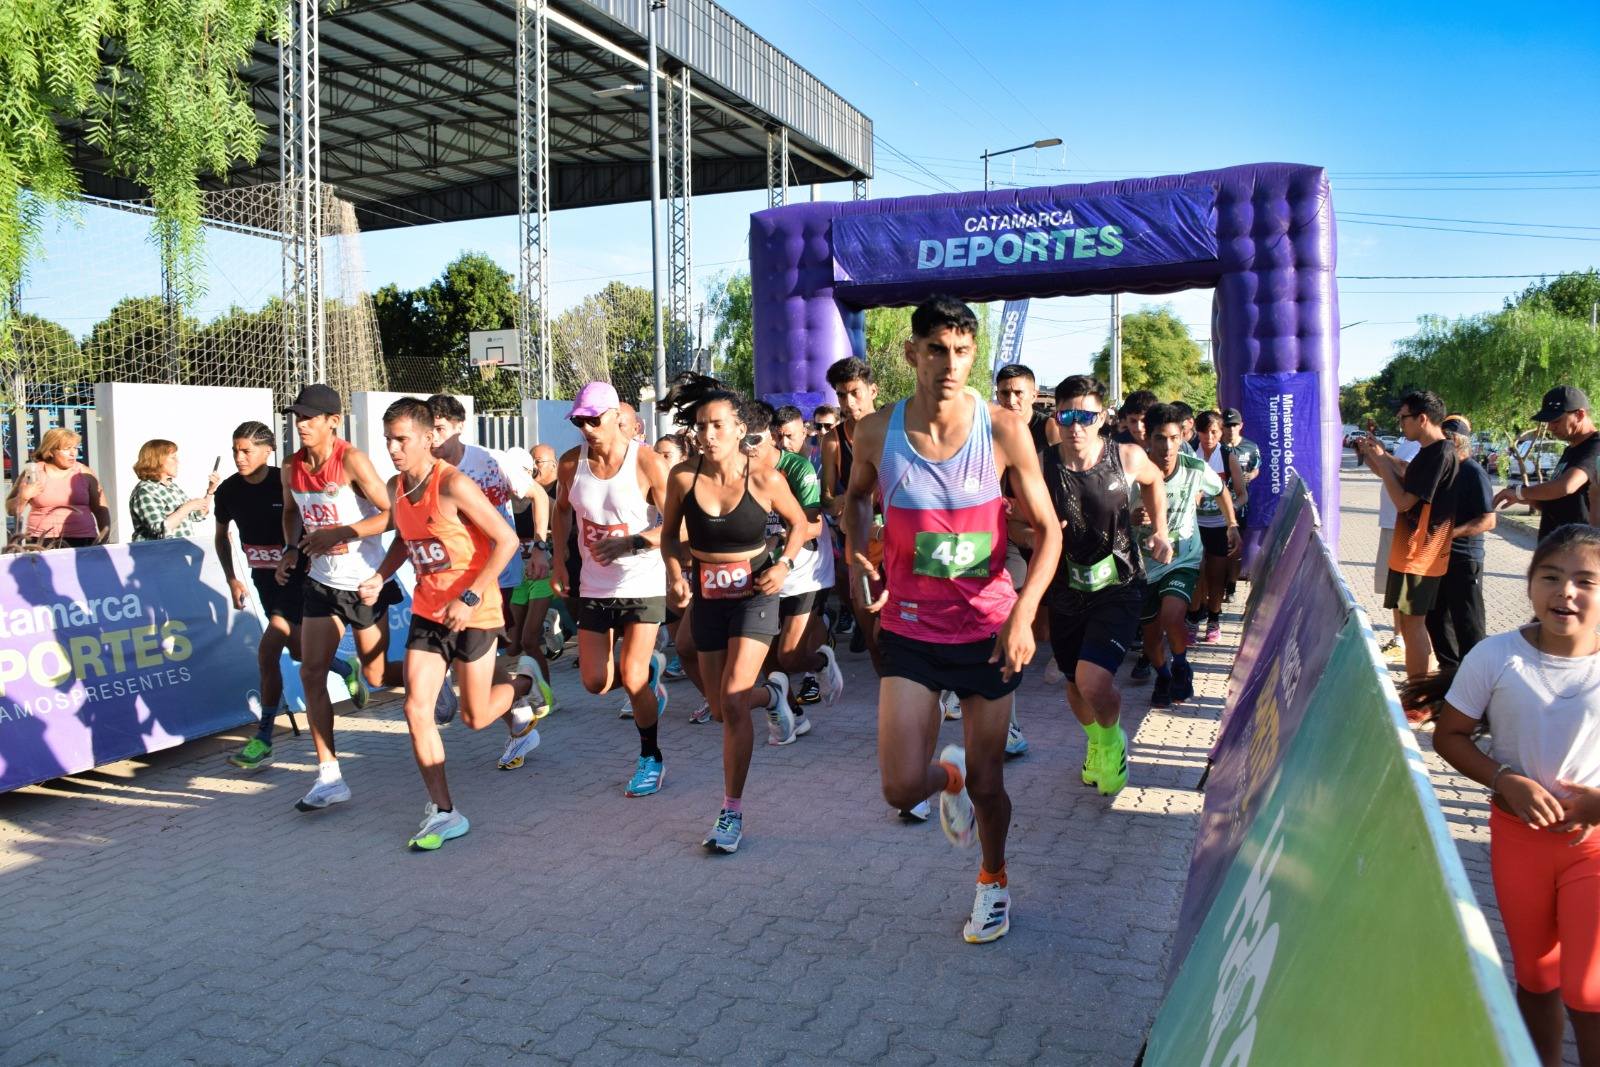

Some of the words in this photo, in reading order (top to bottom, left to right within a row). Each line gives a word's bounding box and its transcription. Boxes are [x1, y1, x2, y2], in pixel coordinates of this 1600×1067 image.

[964, 210, 1074, 233] CATAMARCA
[917, 225, 1124, 270] DEPORTES
[1269, 394, 1281, 440] Turismo
[1282, 394, 1294, 449] Ministerio
[1269, 440, 1279, 449] y
[1284, 449, 1295, 465] de
[1270, 448, 1282, 495] Deporte
[247, 547, 283, 562] 283
[931, 541, 976, 566] 48
[703, 567, 749, 589] 209
[0, 620, 194, 697] PORTES
